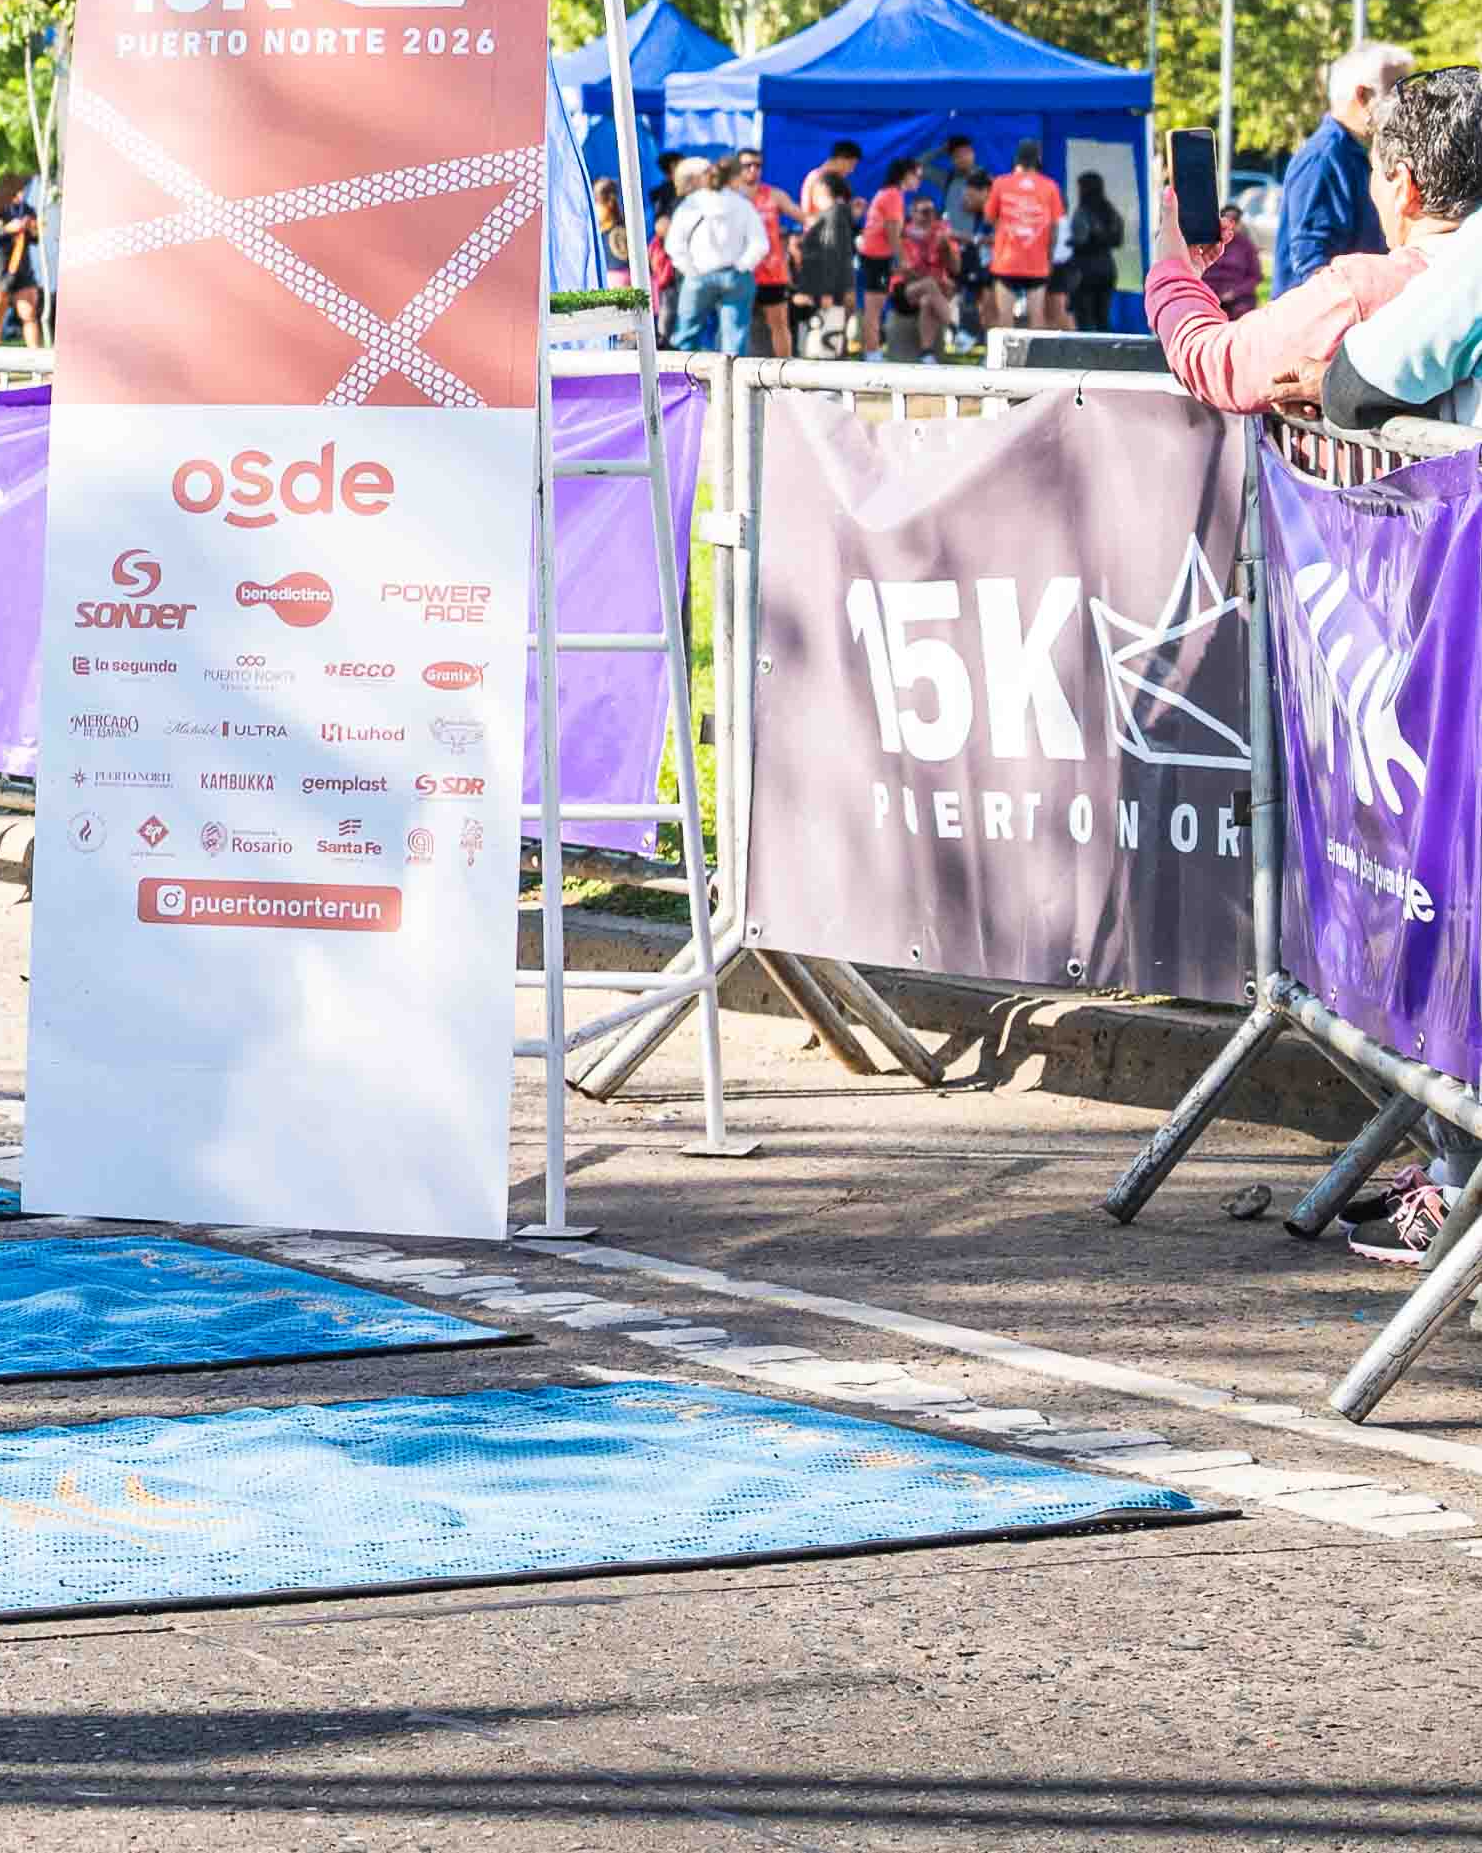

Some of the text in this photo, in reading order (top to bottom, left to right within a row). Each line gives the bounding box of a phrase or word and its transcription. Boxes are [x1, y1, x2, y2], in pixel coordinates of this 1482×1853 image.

[115, 26, 496, 59] PUERTO NORTE 2026
[172, 441, 395, 520] osde
[241, 586, 331, 602] benedictino
[380, 583, 492, 603] POWER
[424, 605, 486, 623] ADE
[95, 656, 179, 677] la segunda
[339, 663, 396, 678] ECCO
[845, 576, 1086, 762] 15K
[234, 724, 288, 738] ULTRA
[346, 726, 406, 741] Luhod
[200, 771, 275, 792] KAMBUKKA
[302, 775, 388, 795] gemplast
[442, 777, 485, 795] SDR
[232, 836, 293, 854] Rosario
[316, 840, 383, 856] Santa Fe
[190, 894, 382, 920] puertonorterun
